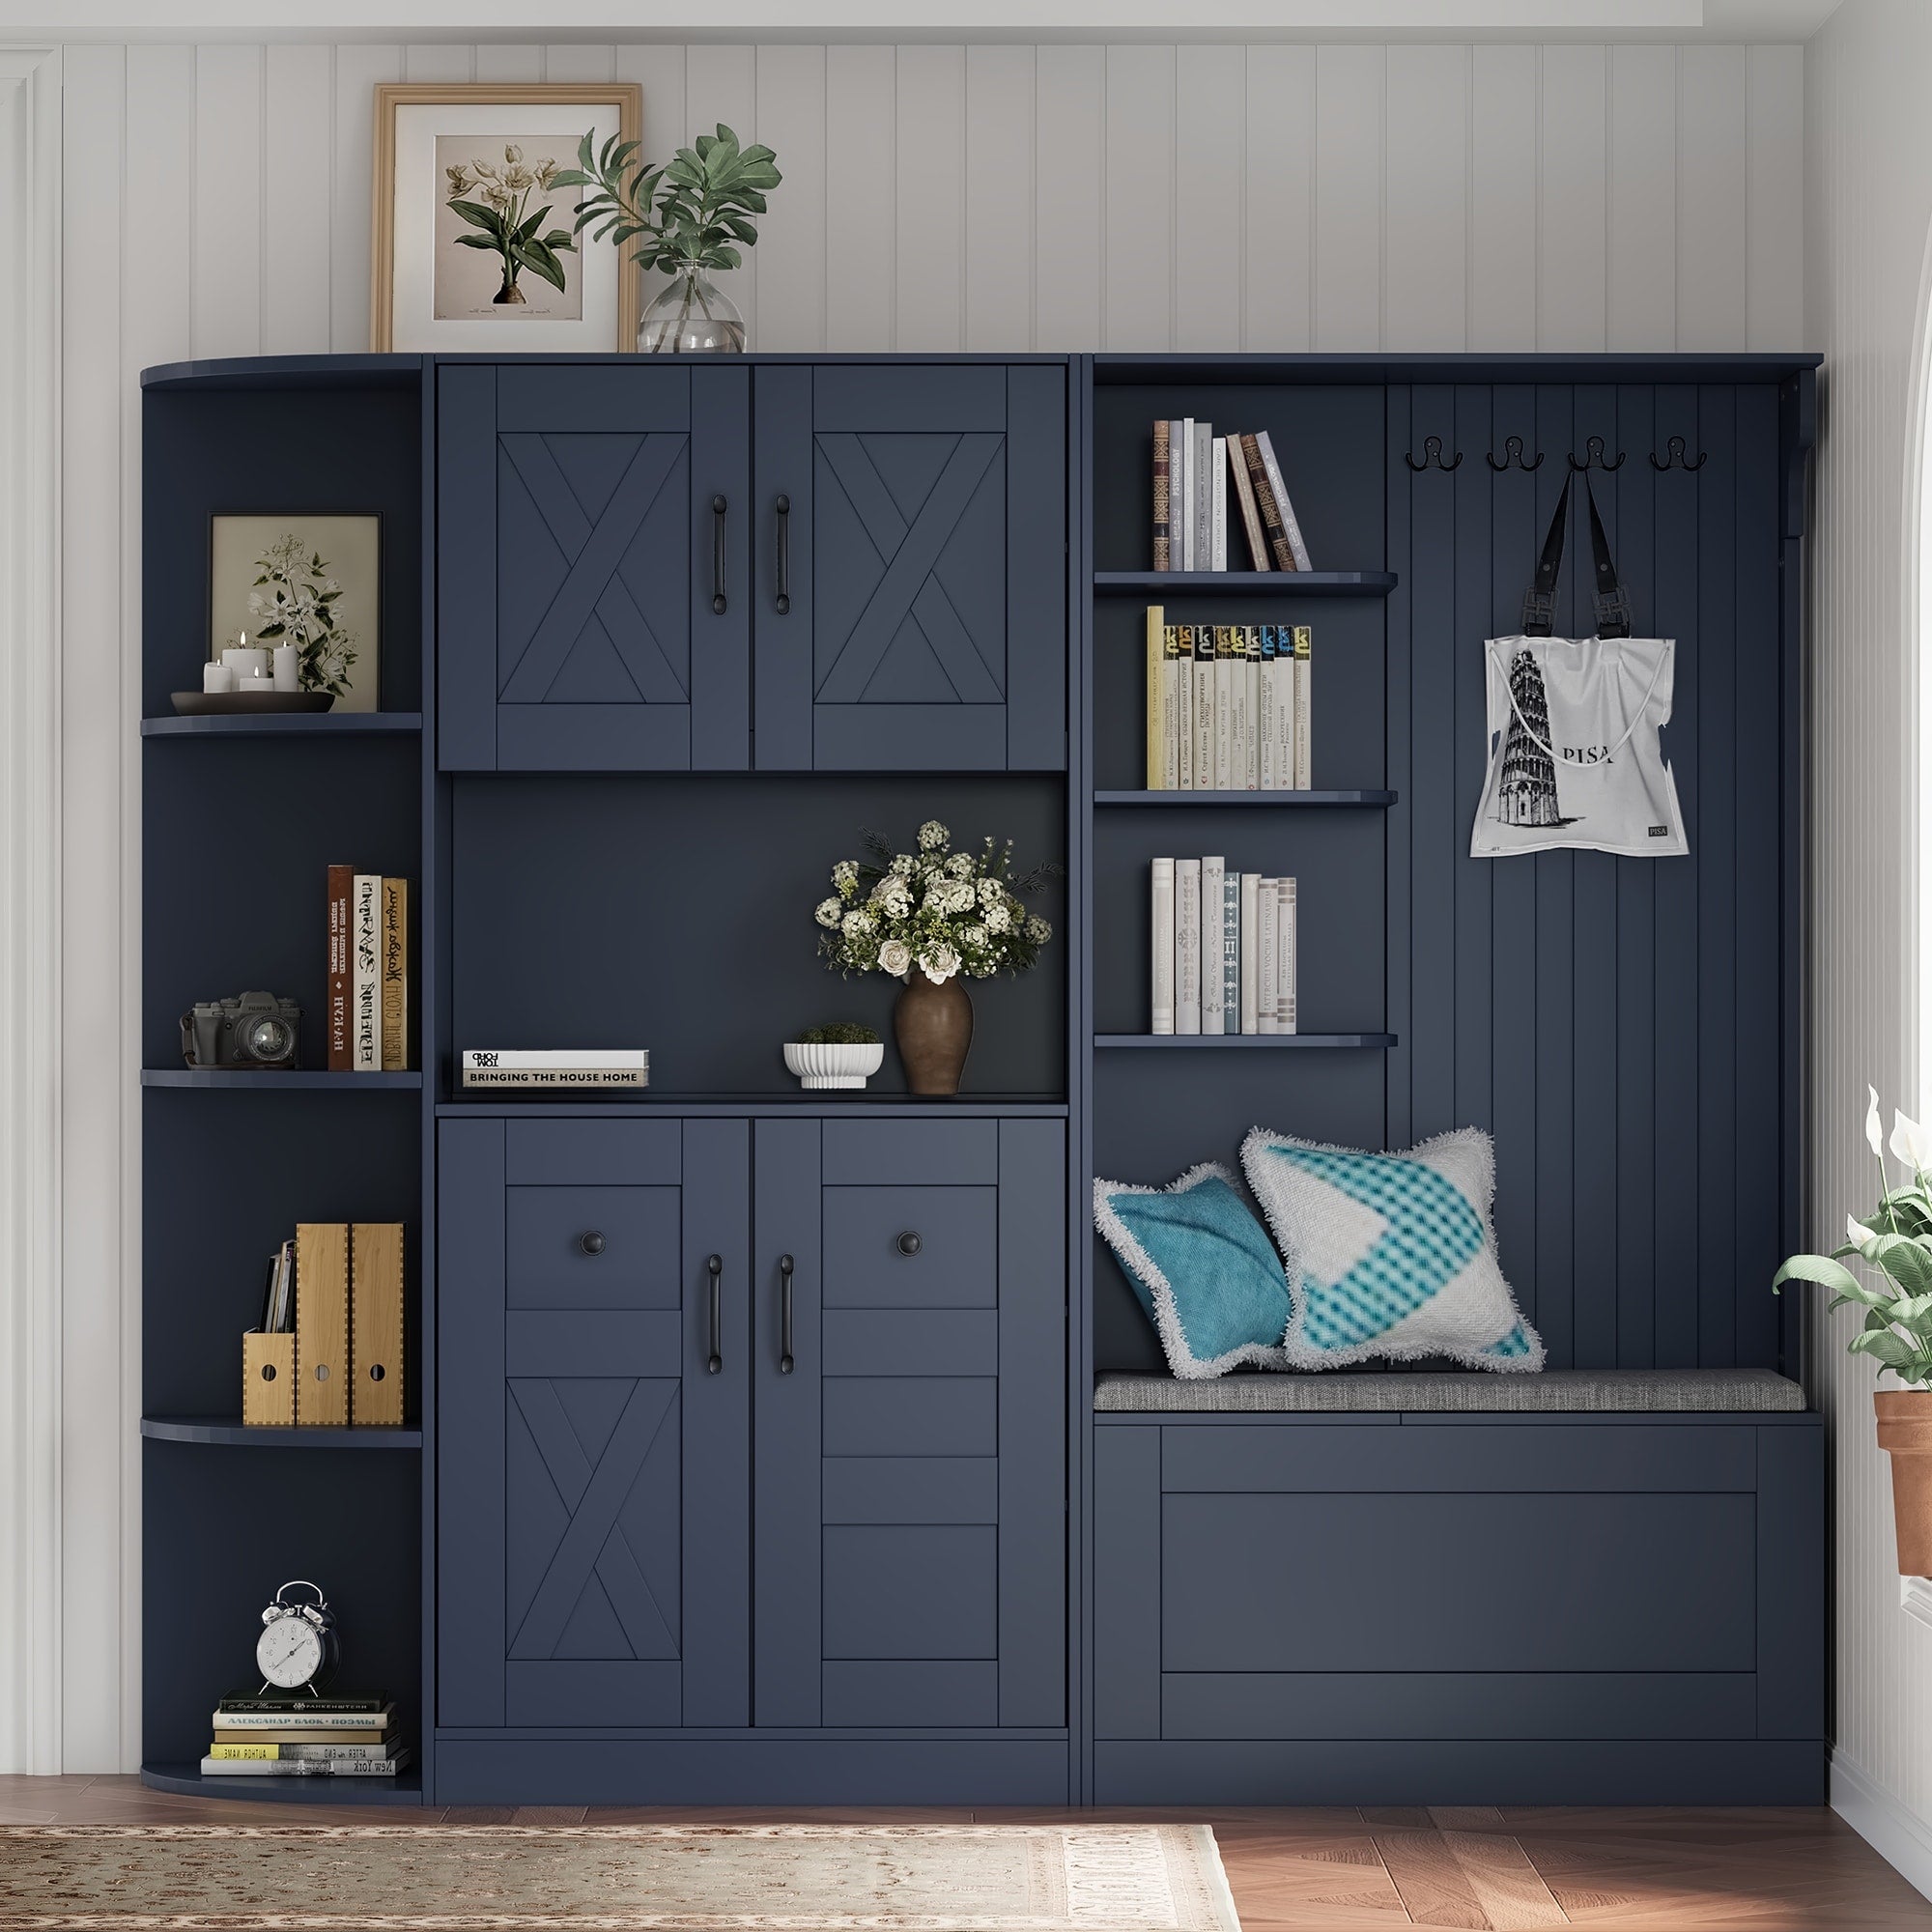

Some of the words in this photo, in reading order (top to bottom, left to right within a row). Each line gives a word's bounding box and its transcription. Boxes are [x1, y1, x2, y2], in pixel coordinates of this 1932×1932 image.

[1562, 746, 1614, 764] PISA
[469, 1073, 528, 1082] BRINGING
[532, 1073, 555, 1082] THE
[559, 1073, 599, 1082] HOUSE
[603, 1073, 638, 1082] HOME
